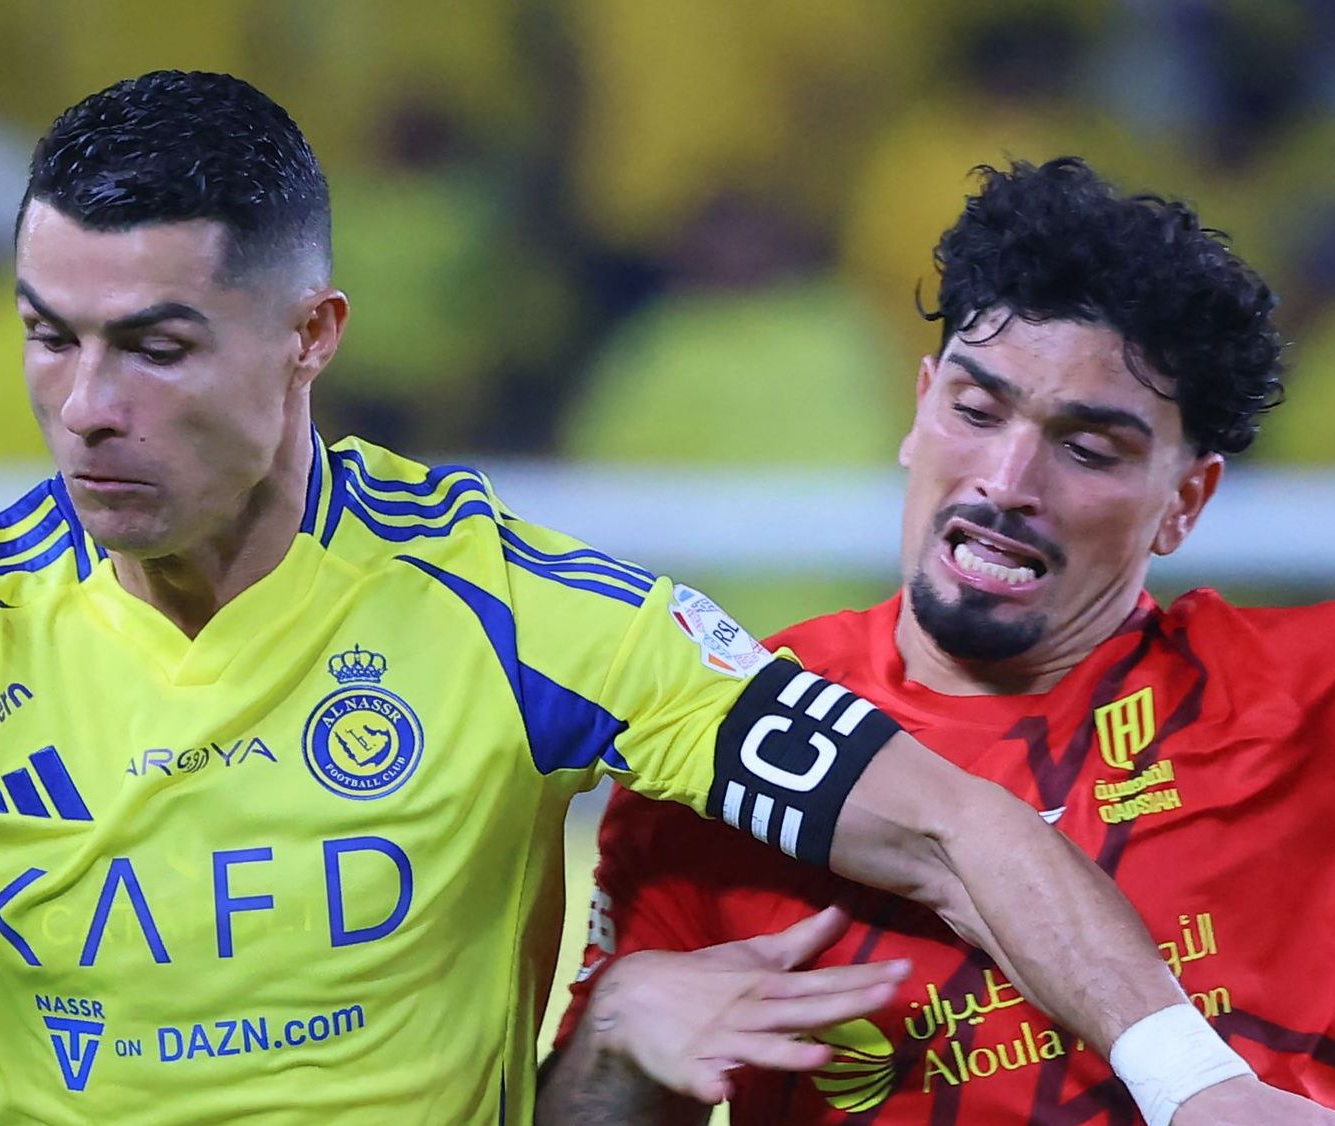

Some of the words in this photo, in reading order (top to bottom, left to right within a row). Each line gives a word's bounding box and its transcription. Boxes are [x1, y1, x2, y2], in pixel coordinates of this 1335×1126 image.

[712, 619, 740, 647] RSL
[321, 705, 344, 729] AL
[344, 697, 402, 724] NASSR
[325, 763, 381, 788] FOOTBALL
[382, 756, 406, 781] CLUB
[34, 994, 105, 1019] NASSR
[115, 1039, 142, 1057] ON
[157, 1004, 365, 1062] DAZN.com
[922, 1022, 1065, 1093] Aloula
